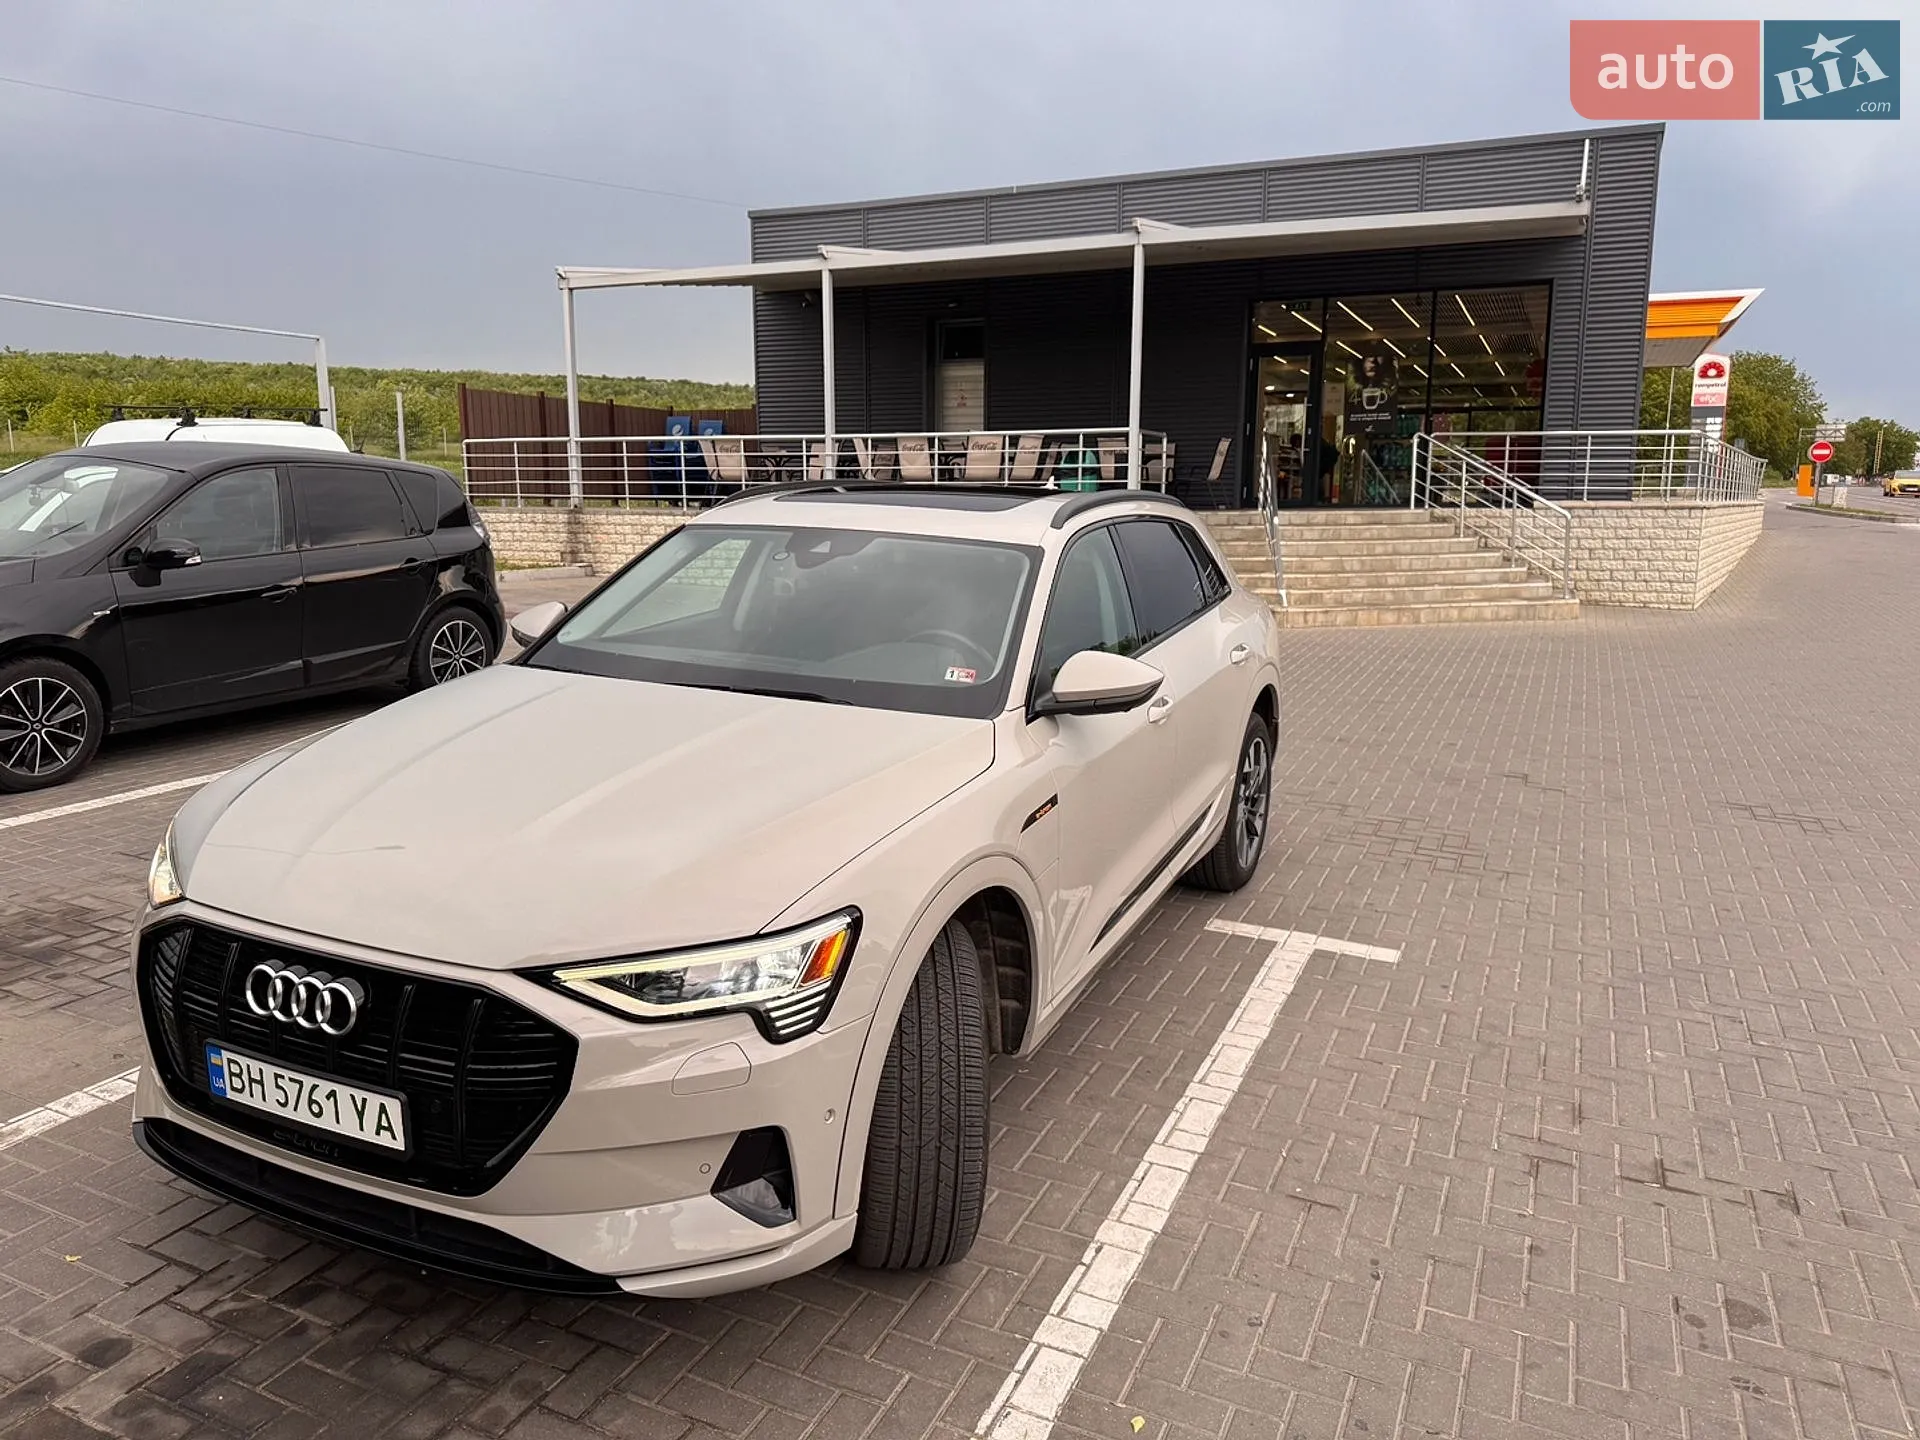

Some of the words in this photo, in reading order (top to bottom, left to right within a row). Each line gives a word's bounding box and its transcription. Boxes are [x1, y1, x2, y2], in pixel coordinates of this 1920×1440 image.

[212, 1075, 225, 1090] UA
[226, 1057, 267, 1102] BH
[273, 1072, 340, 1125] 5761
[350, 1093, 397, 1141] YA
